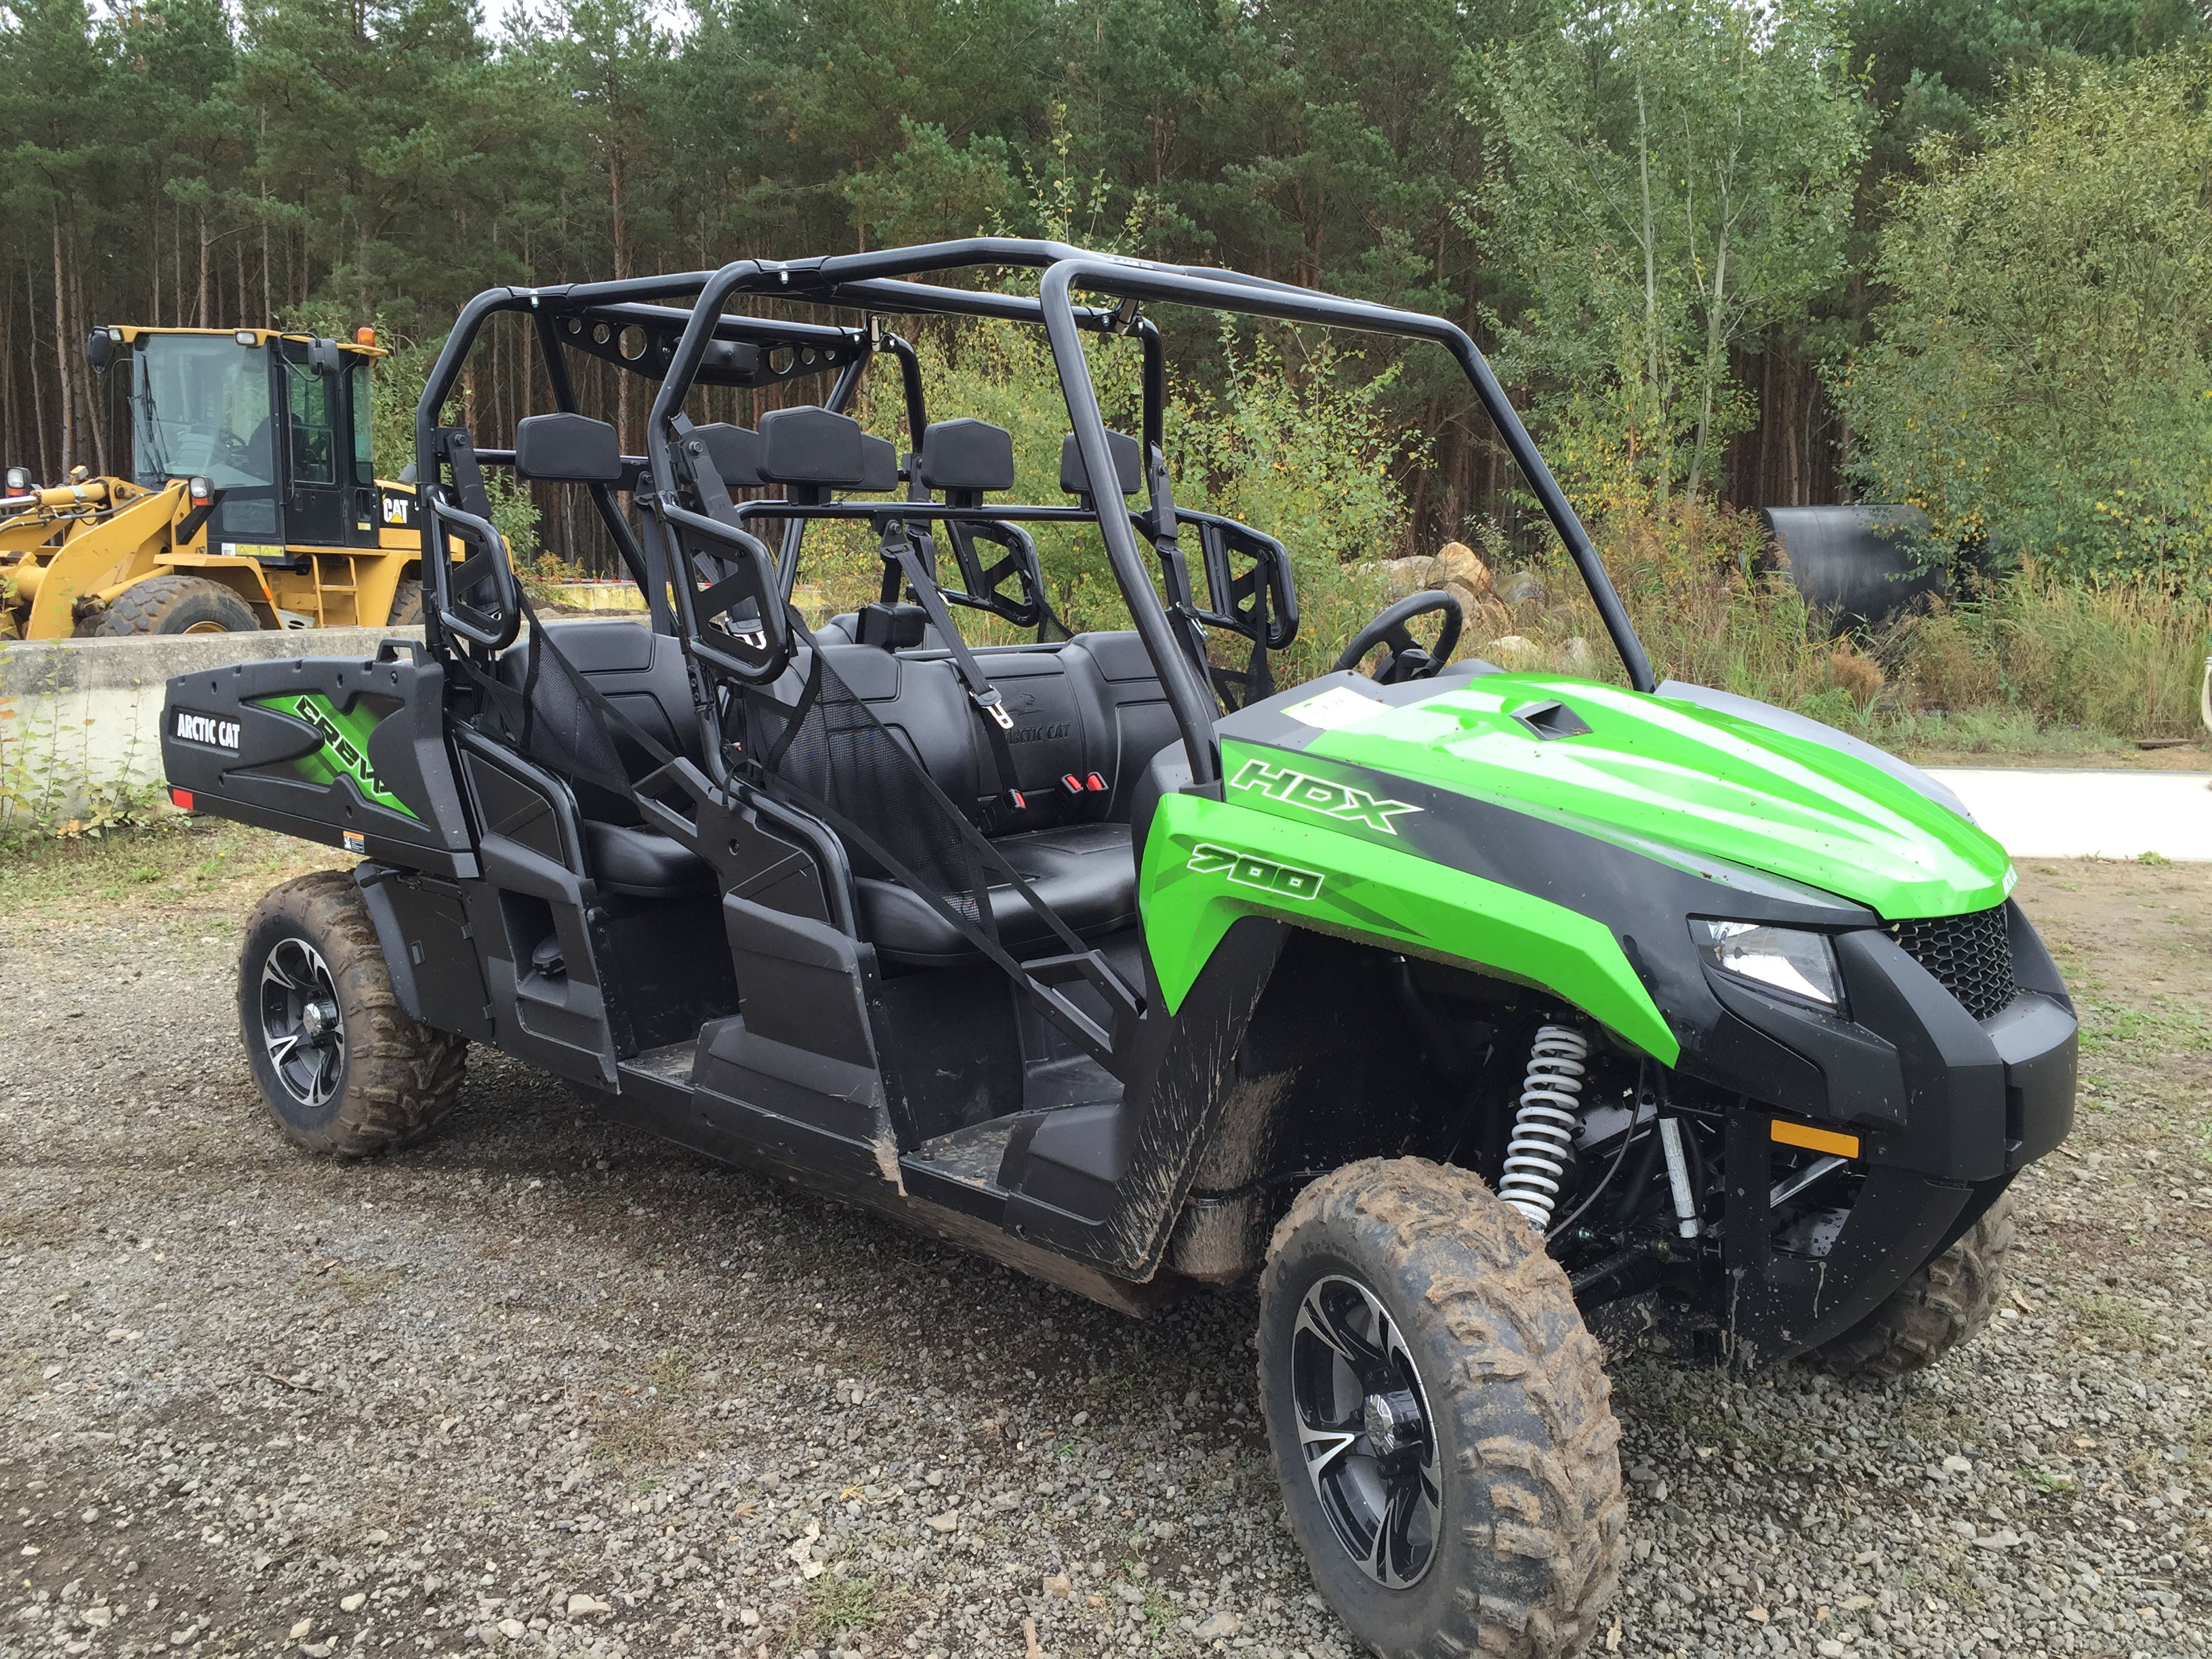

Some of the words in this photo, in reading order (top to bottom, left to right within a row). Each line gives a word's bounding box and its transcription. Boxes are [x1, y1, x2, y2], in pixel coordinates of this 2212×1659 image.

[383, 498, 408, 524] CAT
[178, 713, 216, 744] ARCTIC
[218, 721, 241, 749] CAT
[1046, 722, 1071, 741] CAT
[1229, 758, 1425, 836] HDX
[1187, 843, 1325, 901] 700
